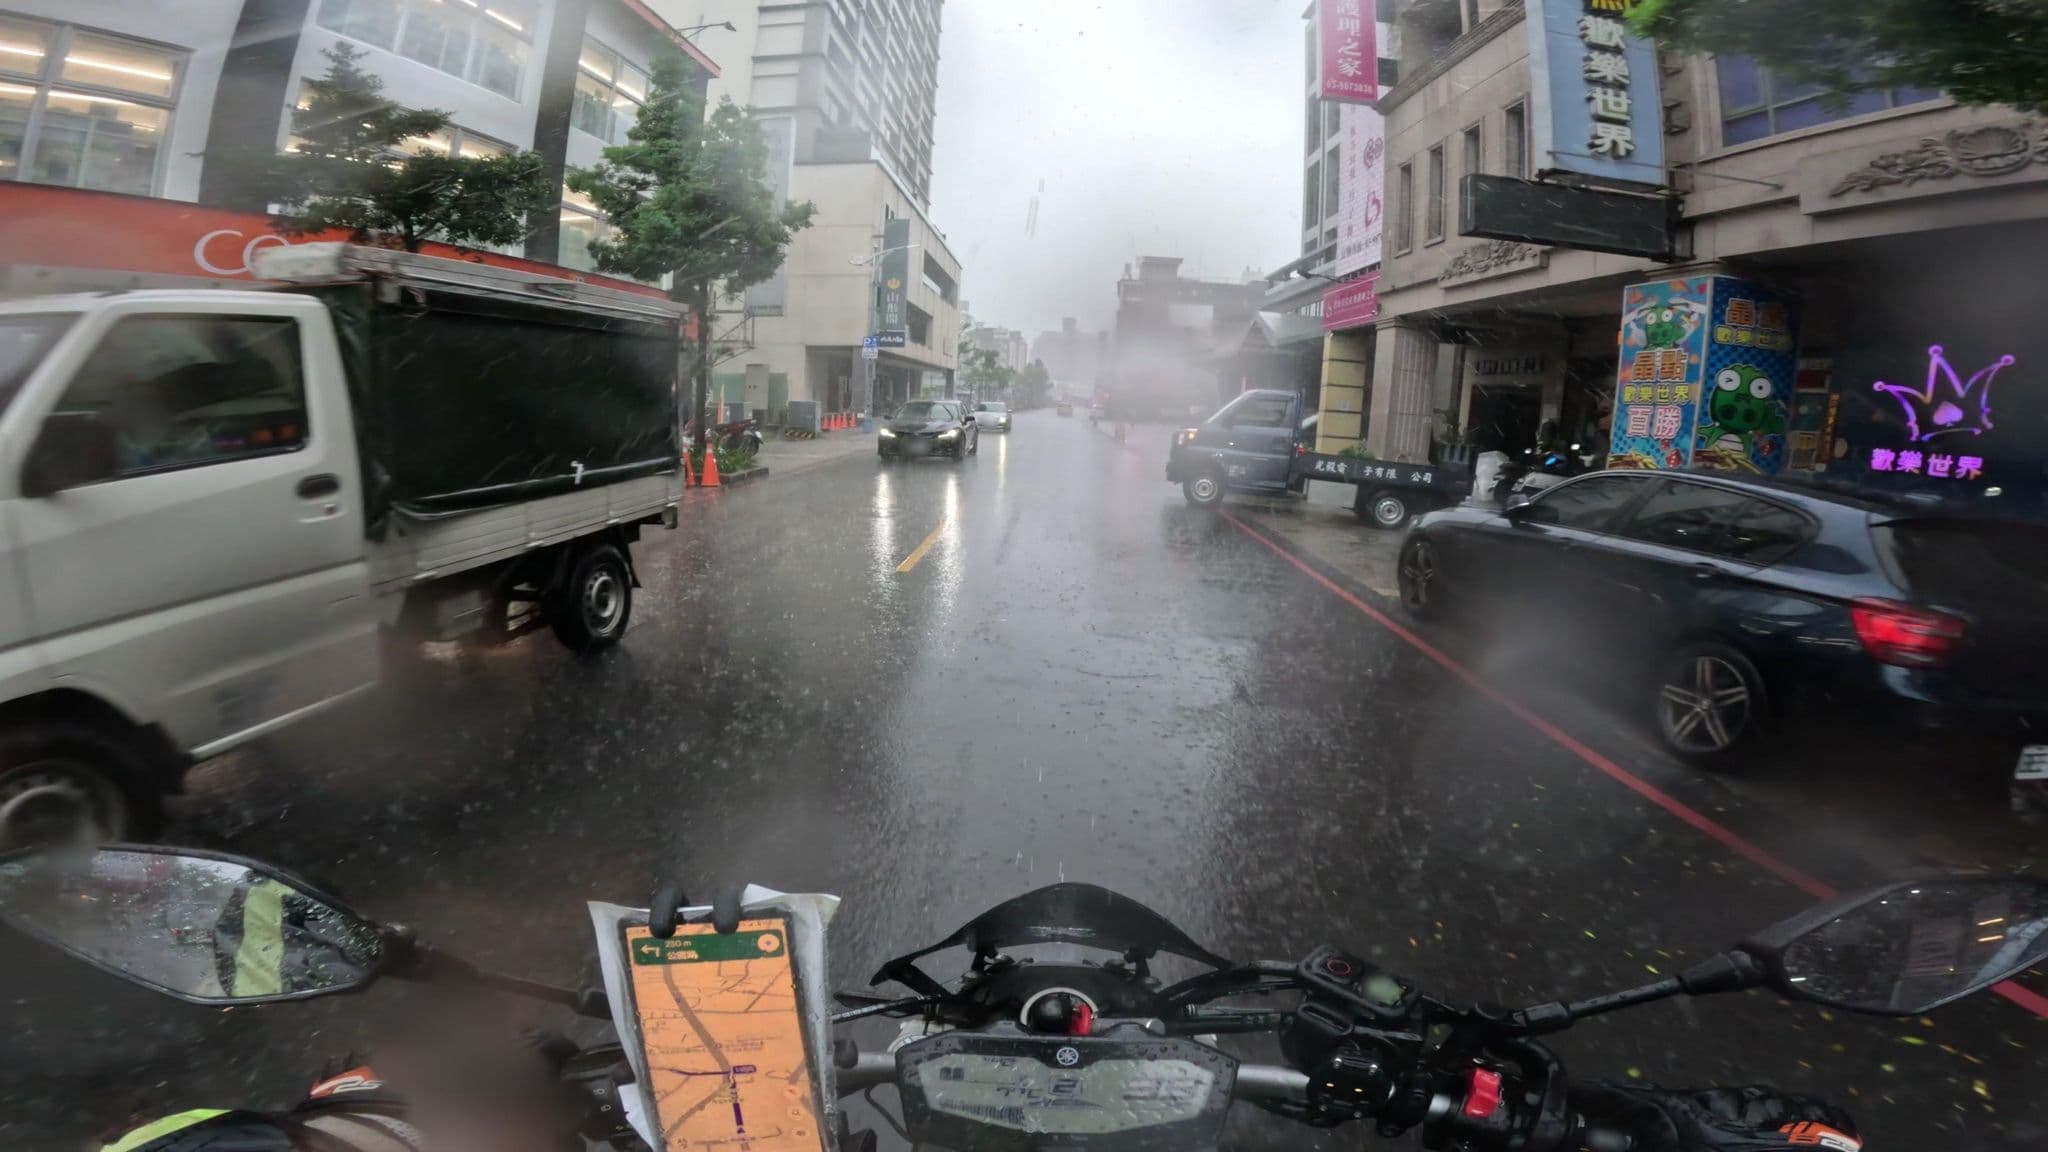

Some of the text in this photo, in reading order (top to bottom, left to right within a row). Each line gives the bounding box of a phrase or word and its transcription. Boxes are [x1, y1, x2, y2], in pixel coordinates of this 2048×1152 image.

[1578, 15, 1635, 157] 歡樂世界
[1632, 350, 1689, 382] 晶點
[1623, 384, 1690, 404] 歡樂世界
[1627, 405, 1681, 439] 百勝
[1871, 448, 1983, 479] 歡樂世界
